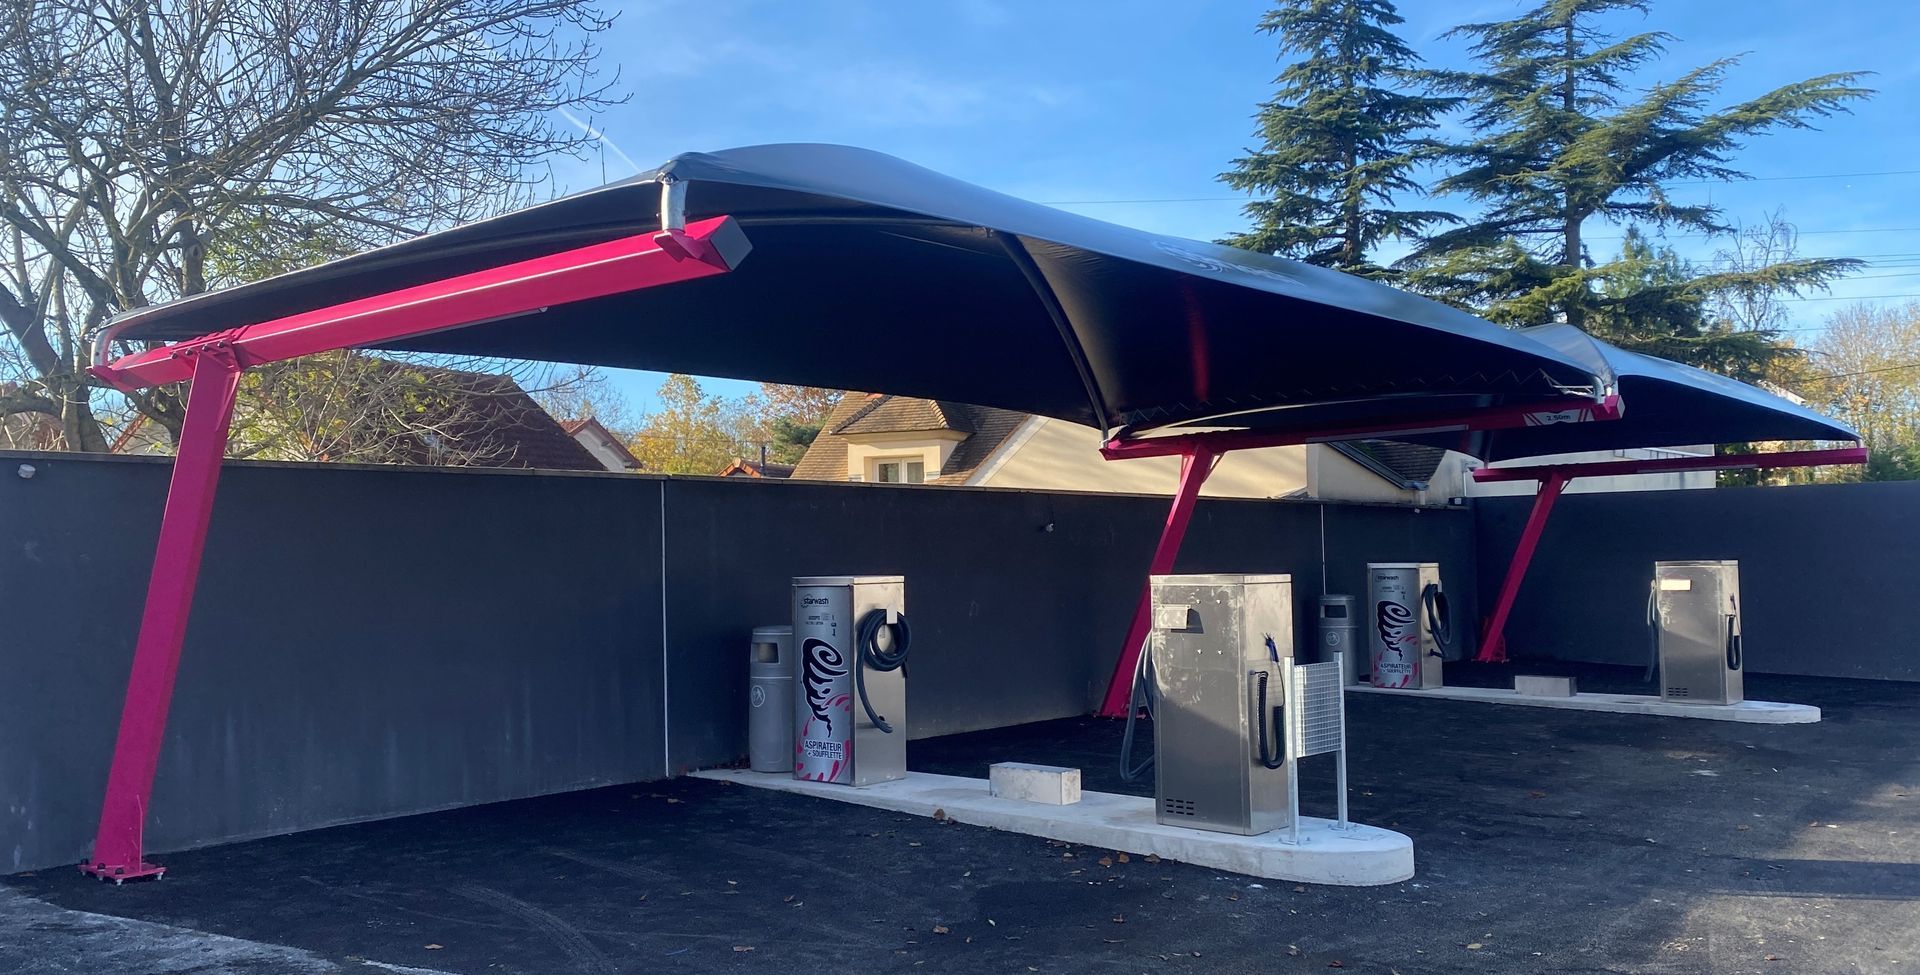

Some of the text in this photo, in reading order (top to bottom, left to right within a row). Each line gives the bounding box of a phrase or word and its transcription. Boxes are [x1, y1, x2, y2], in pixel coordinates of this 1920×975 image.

[803, 597, 829, 605] starwash
[804, 740, 842, 752] ASPIRATEUR
[812, 750, 842, 760] SOUFFLETTE
